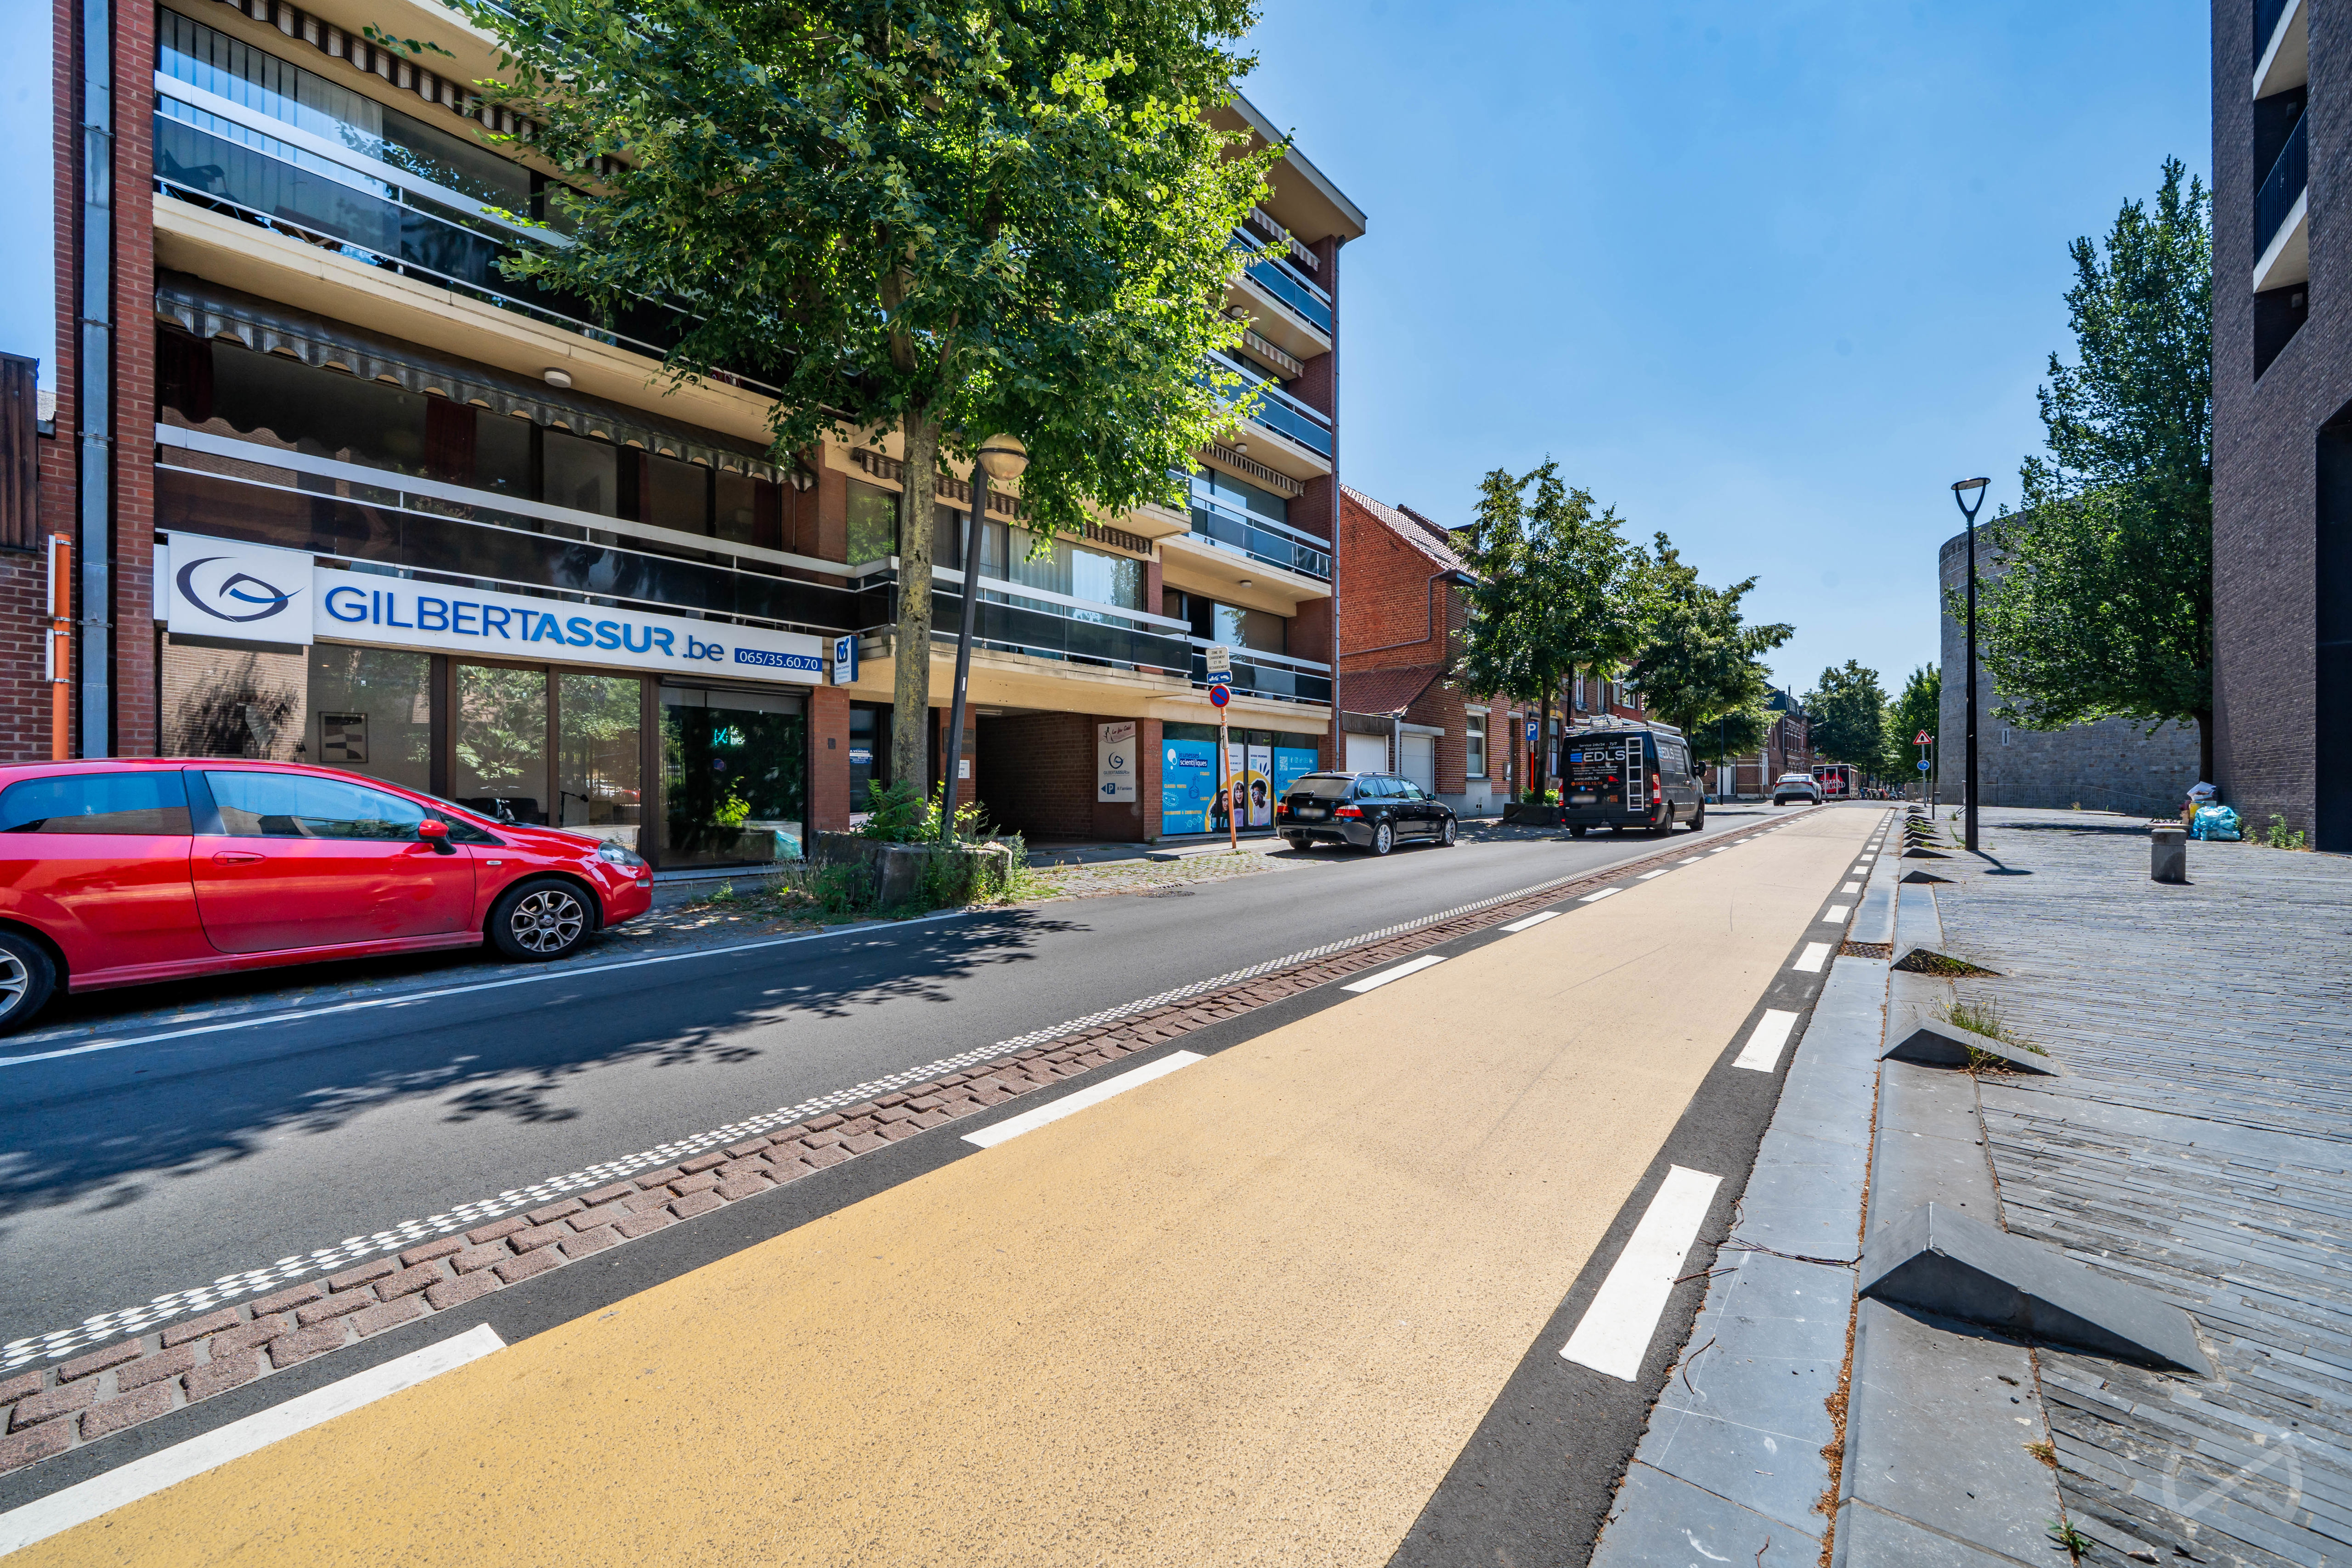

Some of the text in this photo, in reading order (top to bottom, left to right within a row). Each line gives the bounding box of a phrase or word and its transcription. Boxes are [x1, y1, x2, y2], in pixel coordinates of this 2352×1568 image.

[739, 651, 818, 670] 065/35.60.70
[1527, 724, 1536, 736] P
[1583, 750, 1625, 762] EDLS
[1661, 747, 1674, 759] EDLS
[1108, 784, 1114, 793] P
